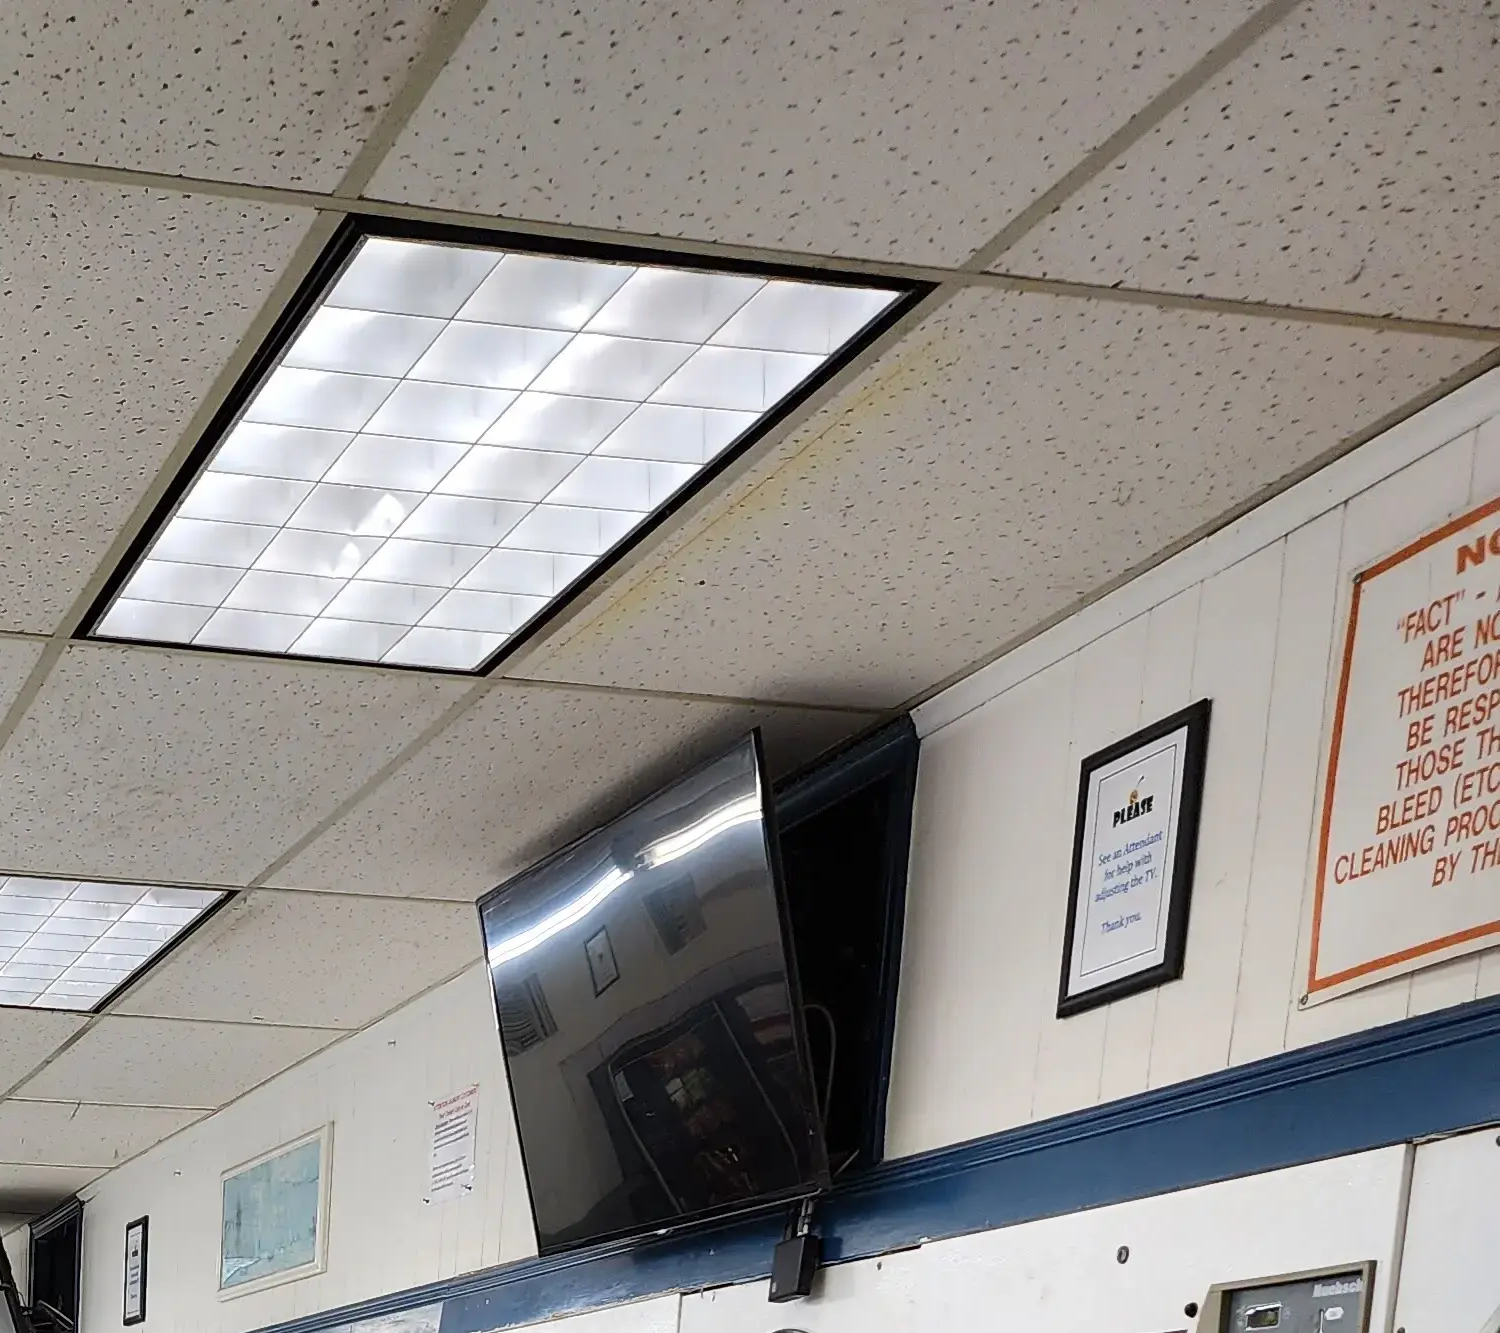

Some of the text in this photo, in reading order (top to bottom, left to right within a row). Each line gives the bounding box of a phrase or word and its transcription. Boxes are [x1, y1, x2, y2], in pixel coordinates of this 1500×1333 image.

[1420, 625, 1466, 672] ARE
[1406, 714, 1436, 752] BE
[1396, 737, 1467, 791] THOSE
[1113, 795, 1154, 828] PLEASE
[1376, 785, 1443, 836] BLEED
[1098, 853, 1112, 866] See
[1123, 830, 1163, 855] Attendant
[1104, 851, 1152, 882] for help with
[1334, 824, 1435, 884] CLEANING
[1432, 837, 1500, 887] BY TH
[1095, 881, 1129, 903] adjusting
[1130, 873, 1143, 888] the
[1101, 915, 1124, 934] Thank
